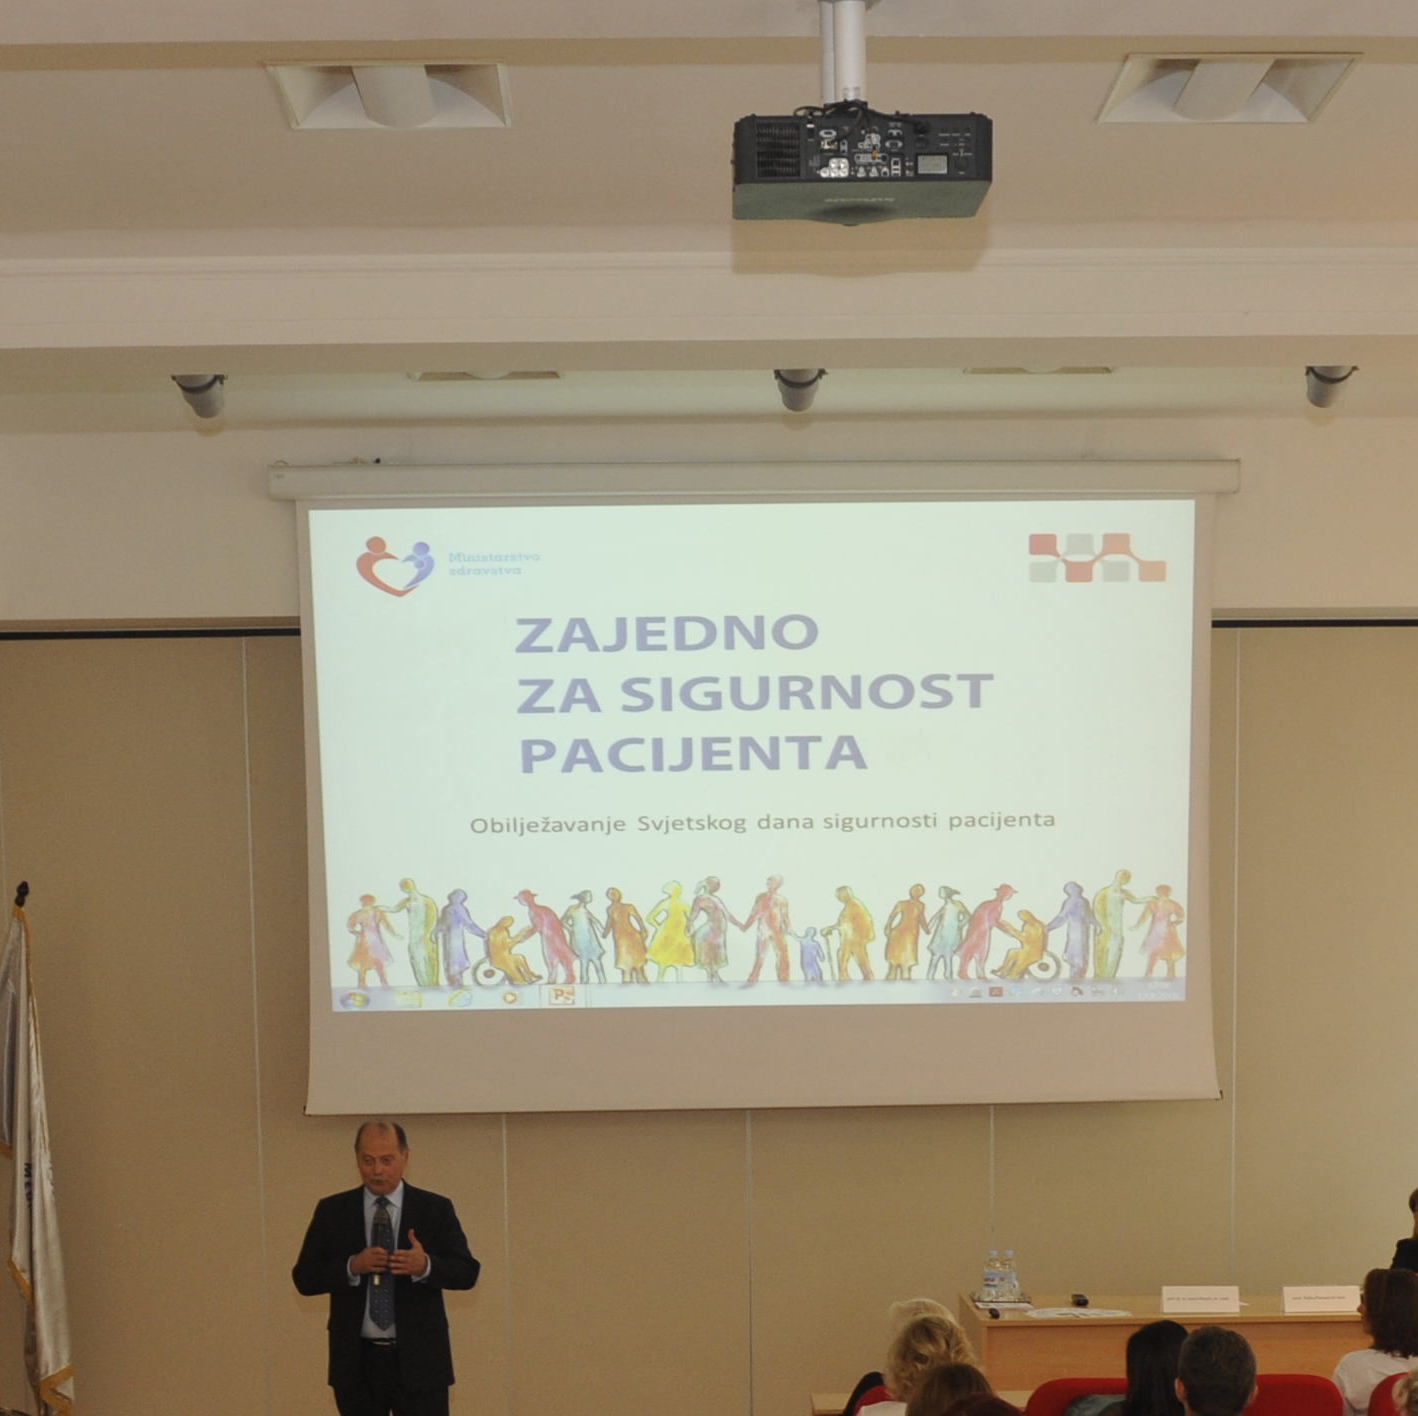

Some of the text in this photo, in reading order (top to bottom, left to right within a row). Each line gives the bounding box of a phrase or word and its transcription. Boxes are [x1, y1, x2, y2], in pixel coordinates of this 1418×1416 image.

[448, 552, 541, 563] Ministarstvo
[449, 564, 522, 576] zdravstva
[515, 614, 819, 653] ZAJEDNO
[517, 673, 995, 714] ZA SIGURNOST
[521, 735, 868, 774] PACIJENTA
[470, 812, 1055, 837] Obilježavanje Svjetskog dana sigurnosti pacijenta
